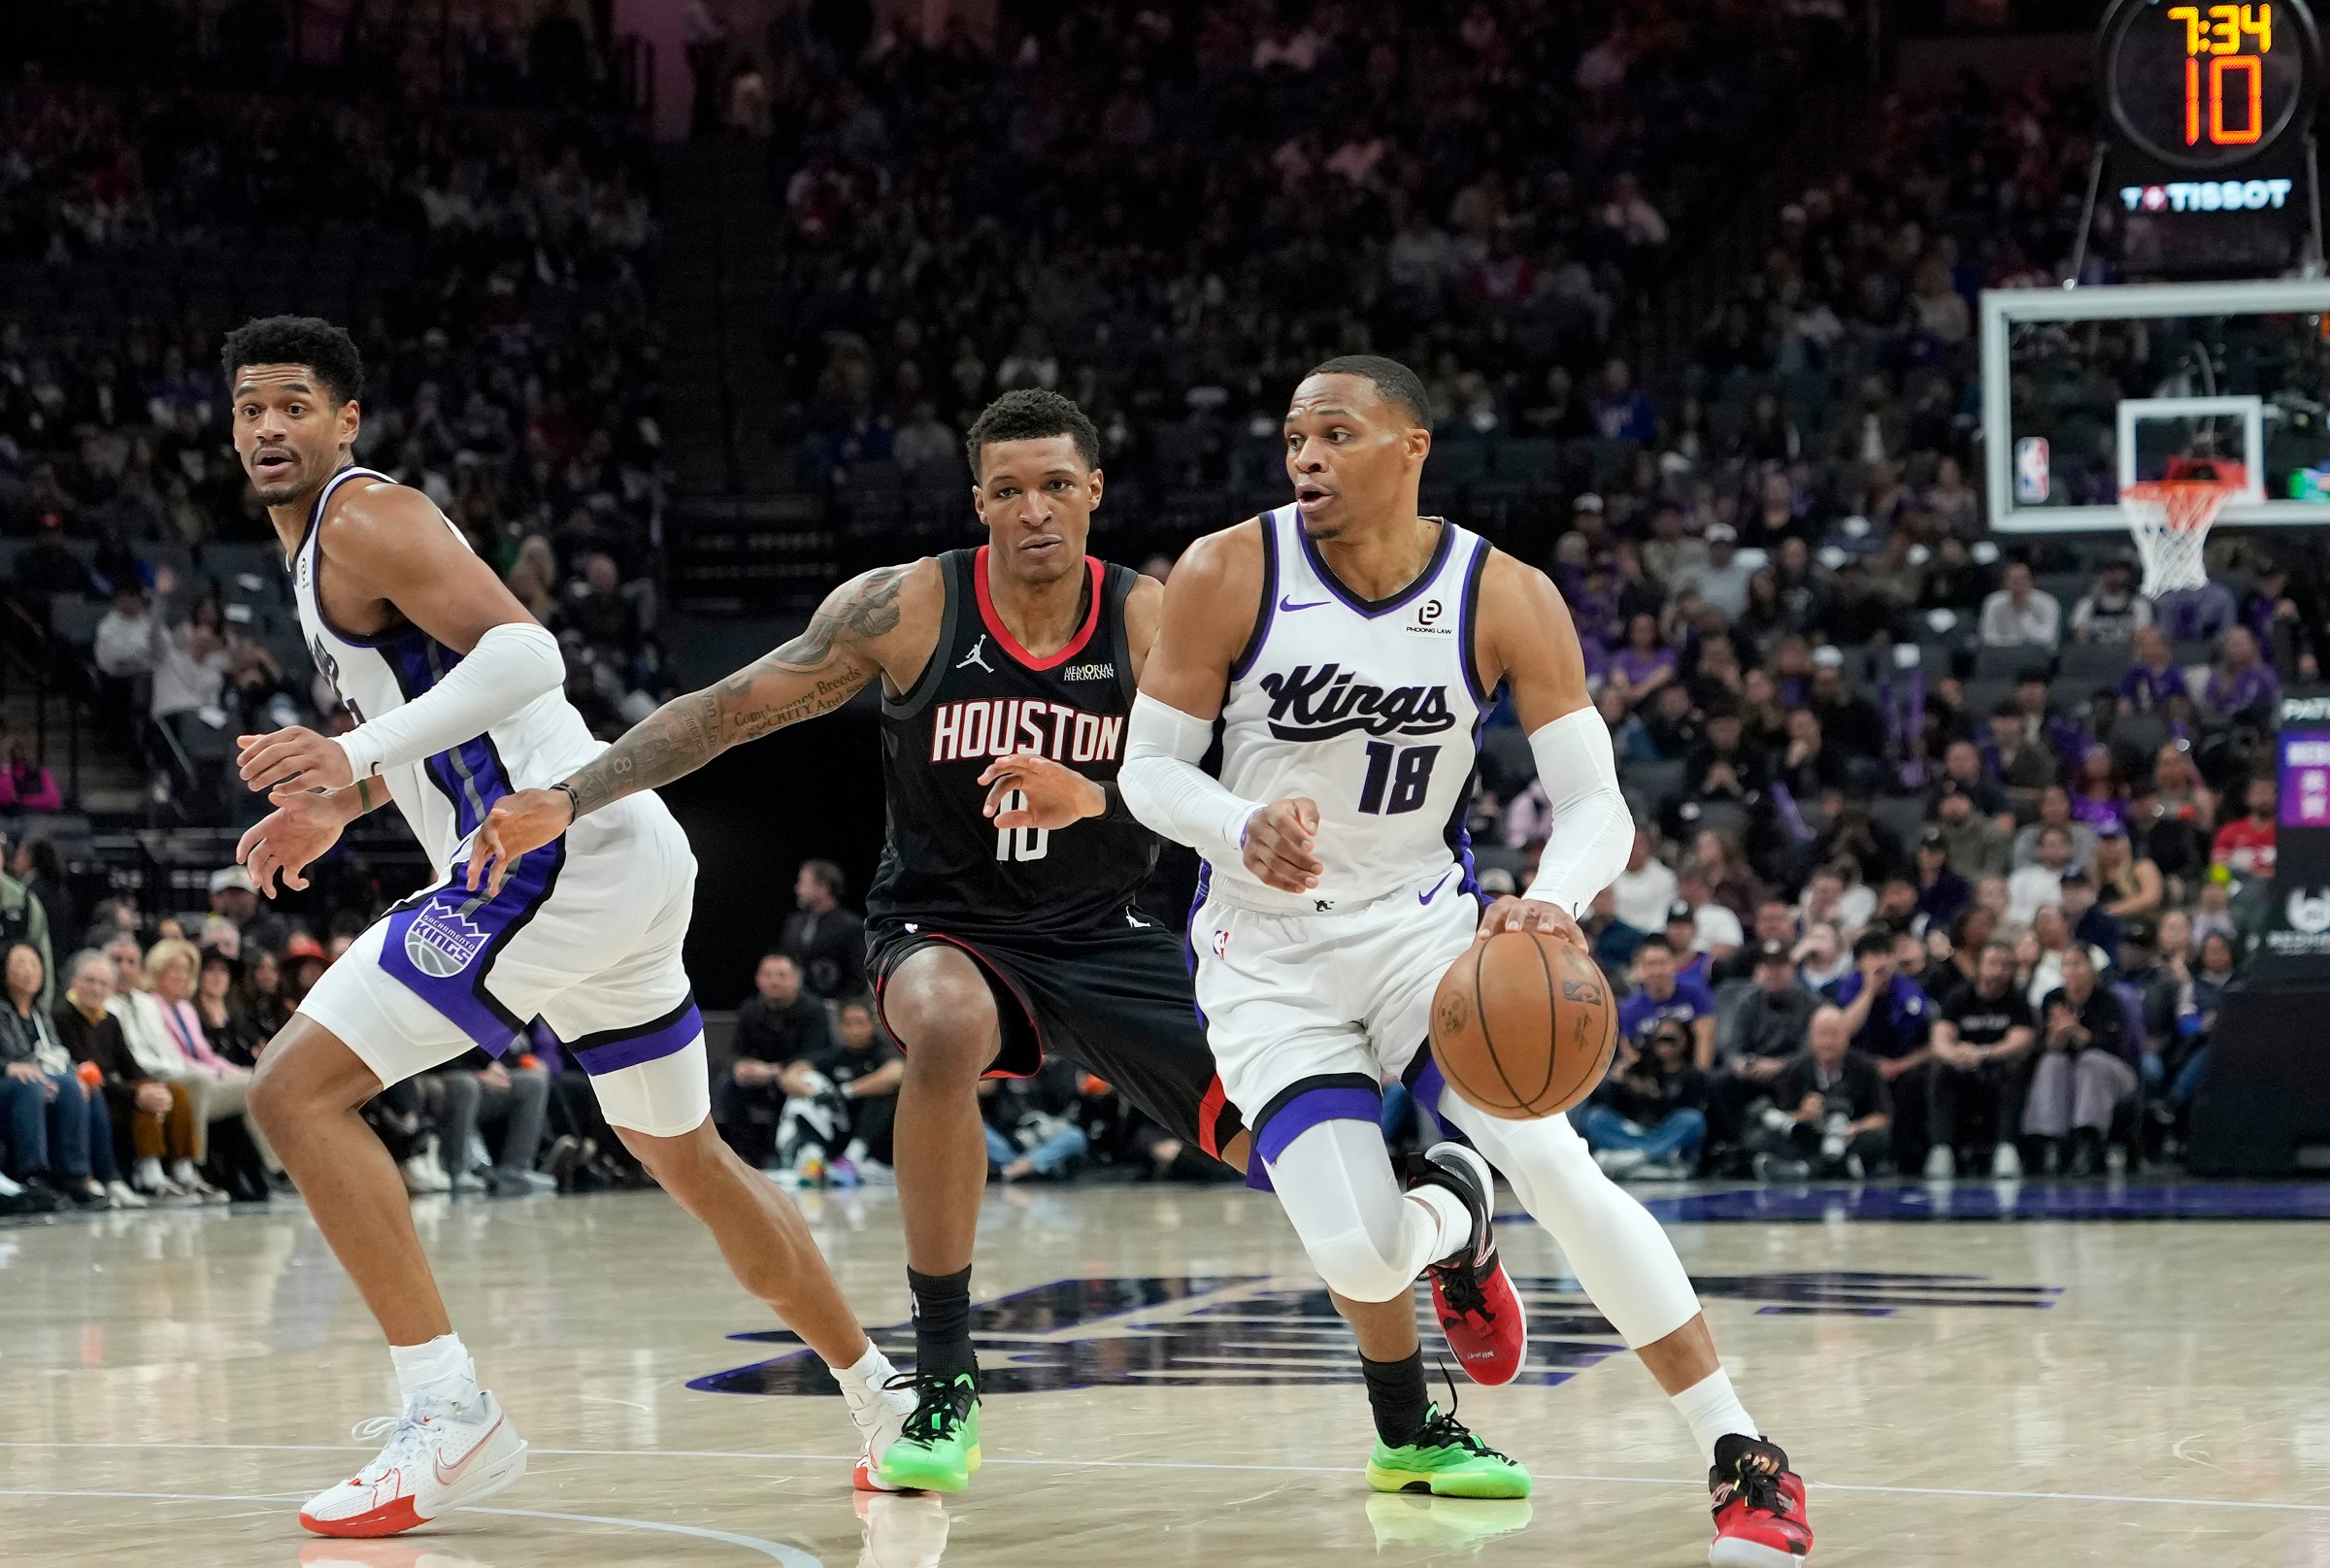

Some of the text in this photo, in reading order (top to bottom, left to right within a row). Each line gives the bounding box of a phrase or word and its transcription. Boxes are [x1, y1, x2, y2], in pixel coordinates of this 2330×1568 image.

[2168, 4, 2272, 55] 7:34
[2186, 55, 2262, 145] 10
[2166, 179, 2292, 212] TISSOT
[815, 666, 862, 695] Breeds
[1063, 669, 1115, 682] HERMANN
[1065, 662, 1115, 675] MEMORIAL
[1259, 663, 1456, 743] Kings
[933, 699, 1124, 763] HOUSTON
[1357, 741, 1444, 816] 18
[412, 920, 471, 966] KINGS
[422, 914, 476, 951] SACRAMENTO
